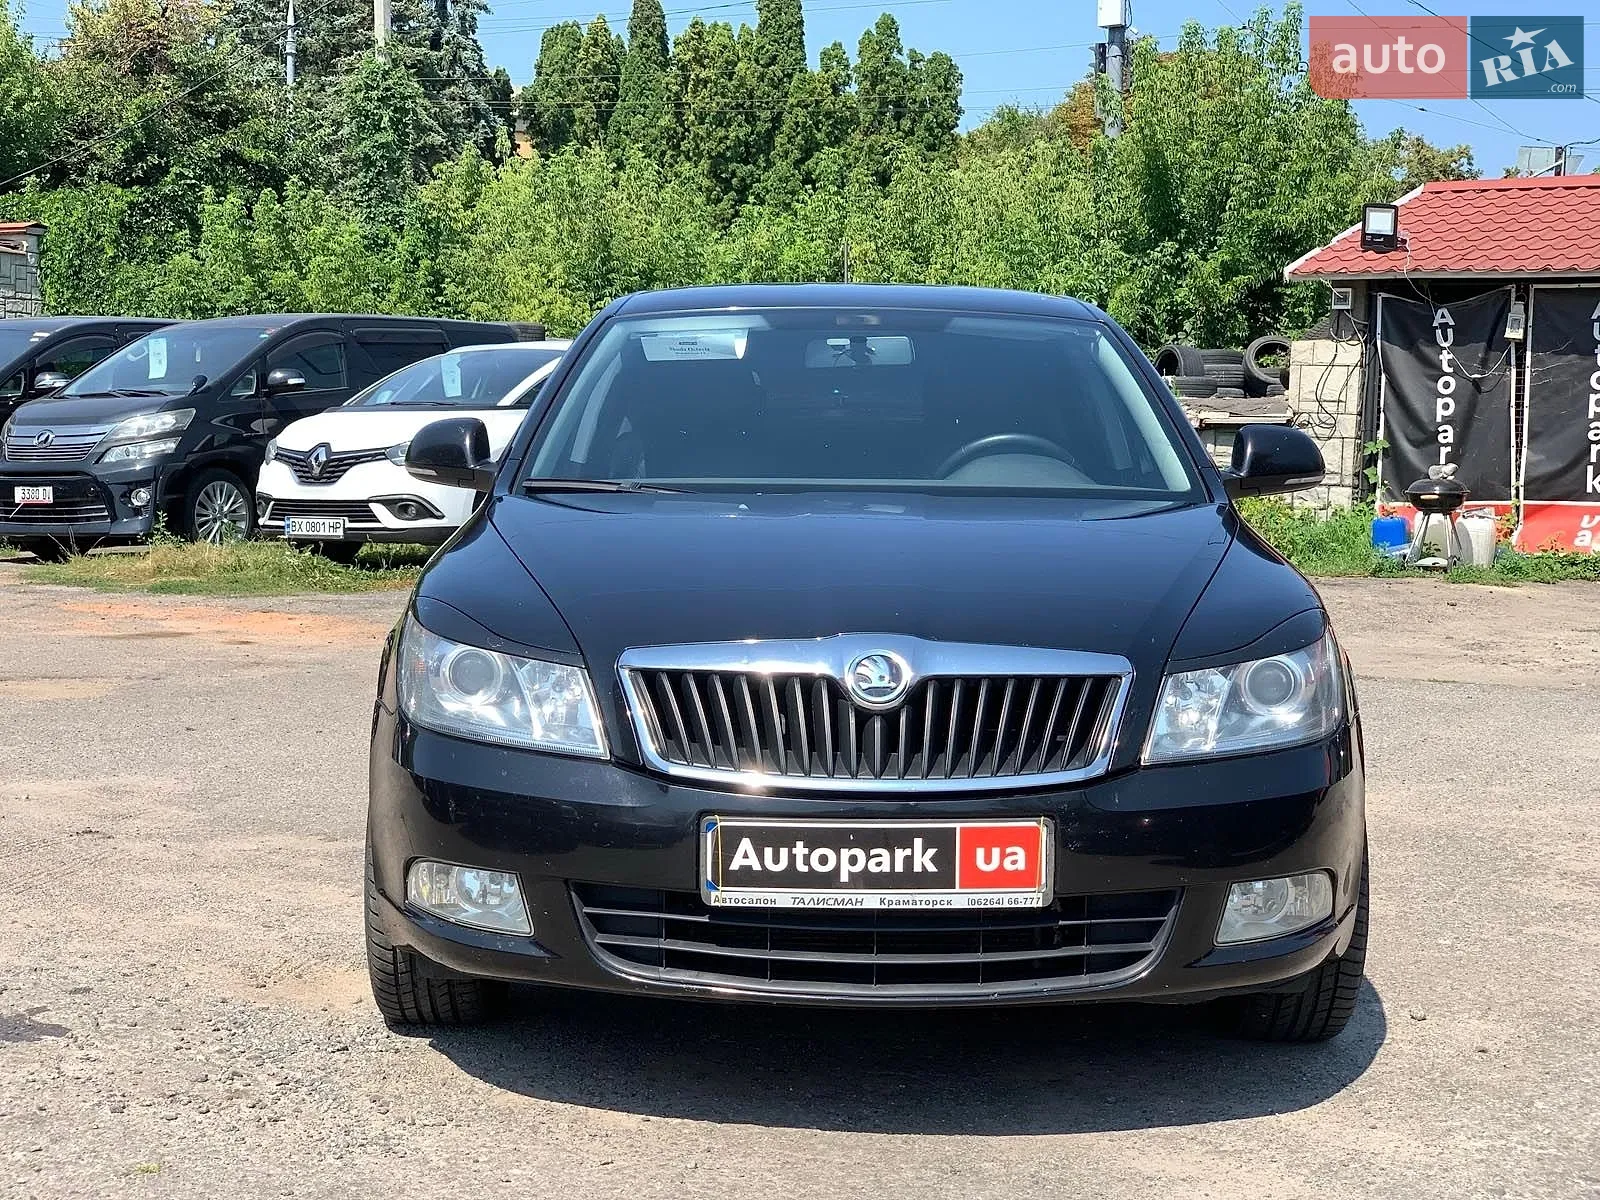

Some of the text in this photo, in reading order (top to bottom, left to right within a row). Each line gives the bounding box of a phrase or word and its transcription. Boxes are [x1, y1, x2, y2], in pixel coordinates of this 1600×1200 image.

[1432, 307, 1457, 465] Autopar
[291, 521, 304, 533] BX
[306, 521, 326, 534] 0801
[728, 837, 1026, 882] Autopark ua
[713, 895, 776, 905] Автосалон
[790, 896, 865, 907] ТАЛИСМАН
[879, 897, 953, 907] Краматорск
[1007, 896, 1041, 906] 66-777
